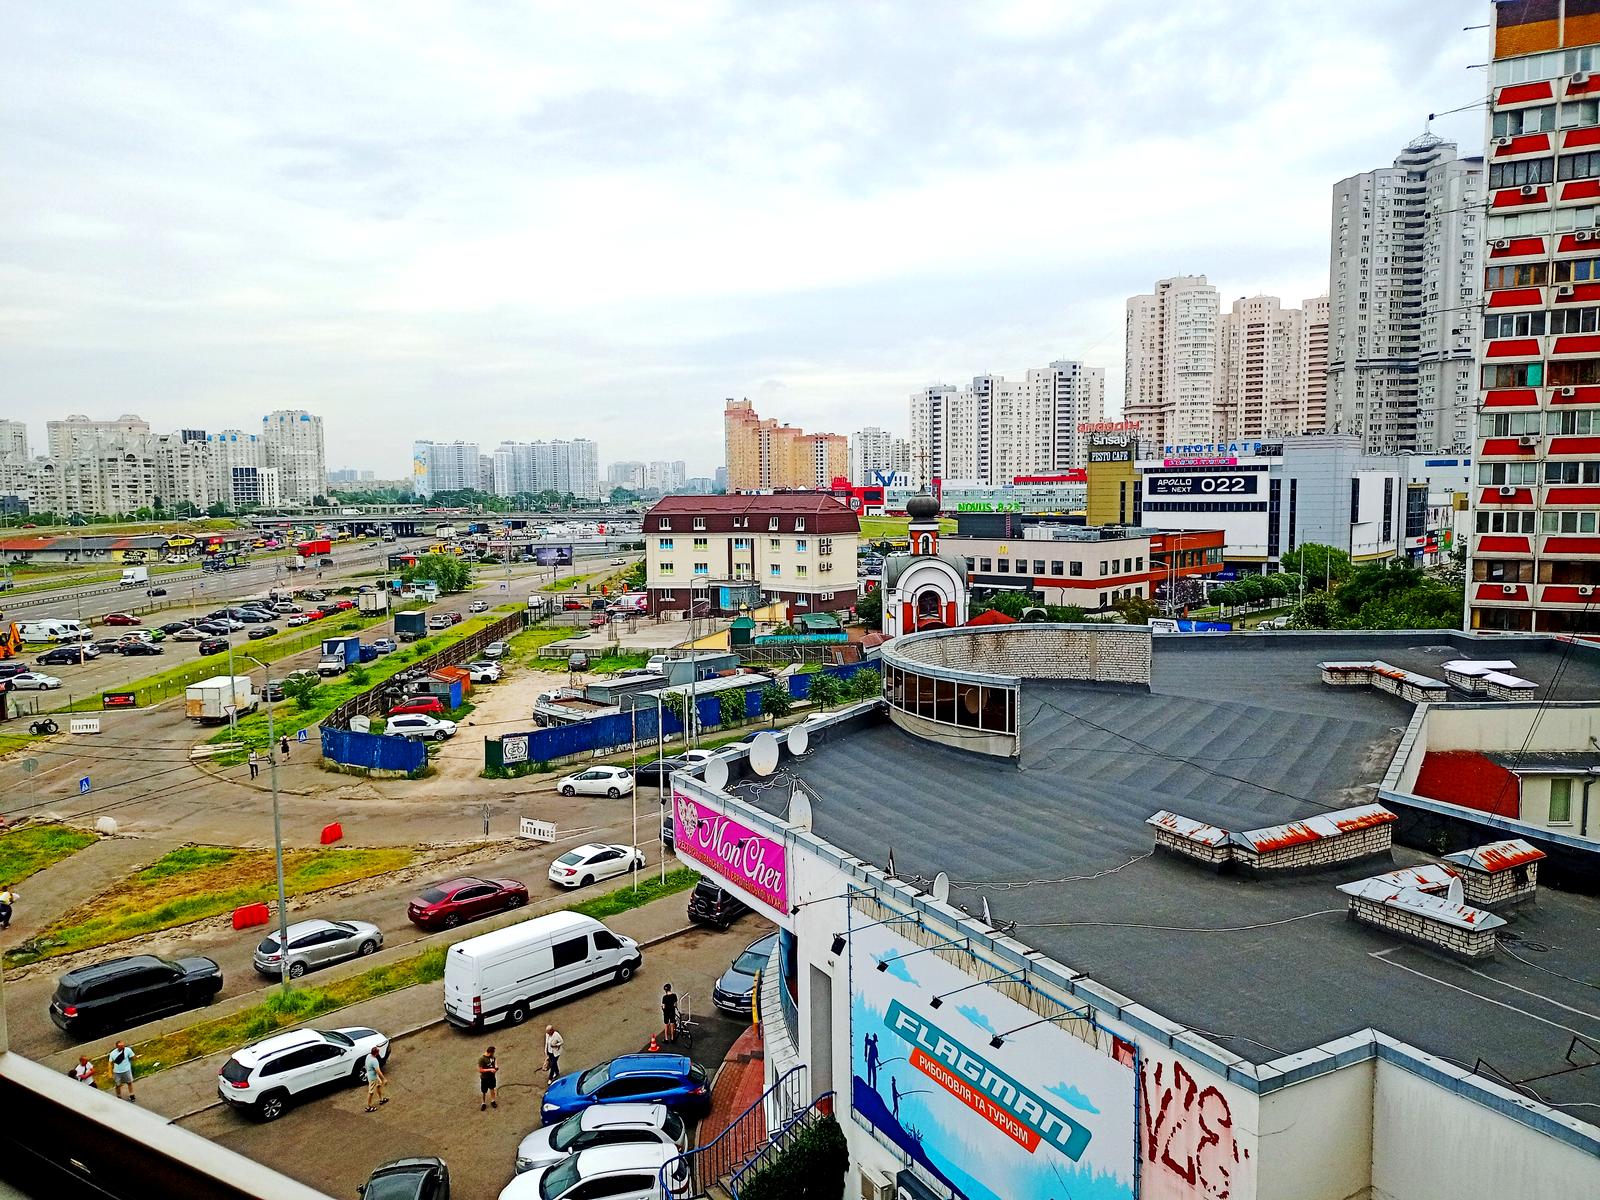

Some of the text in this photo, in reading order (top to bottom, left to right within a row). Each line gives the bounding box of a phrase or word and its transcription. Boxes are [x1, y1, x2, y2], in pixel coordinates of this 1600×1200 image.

[1165, 442, 1262, 453] КІНОТЕАТР
[1091, 452, 1111, 461] PESTO
[1157, 478, 1245, 492] APOLLO 022
[957, 502, 993, 511] NOVUS
[699, 816, 742, 868] Mon
[742, 837, 783, 893] Cher
[895, 1010, 1072, 1146] FLAGMAN
[919, 1055, 1029, 1145] РИБОЛОВЛЯ ТА ТУРИЗМ
